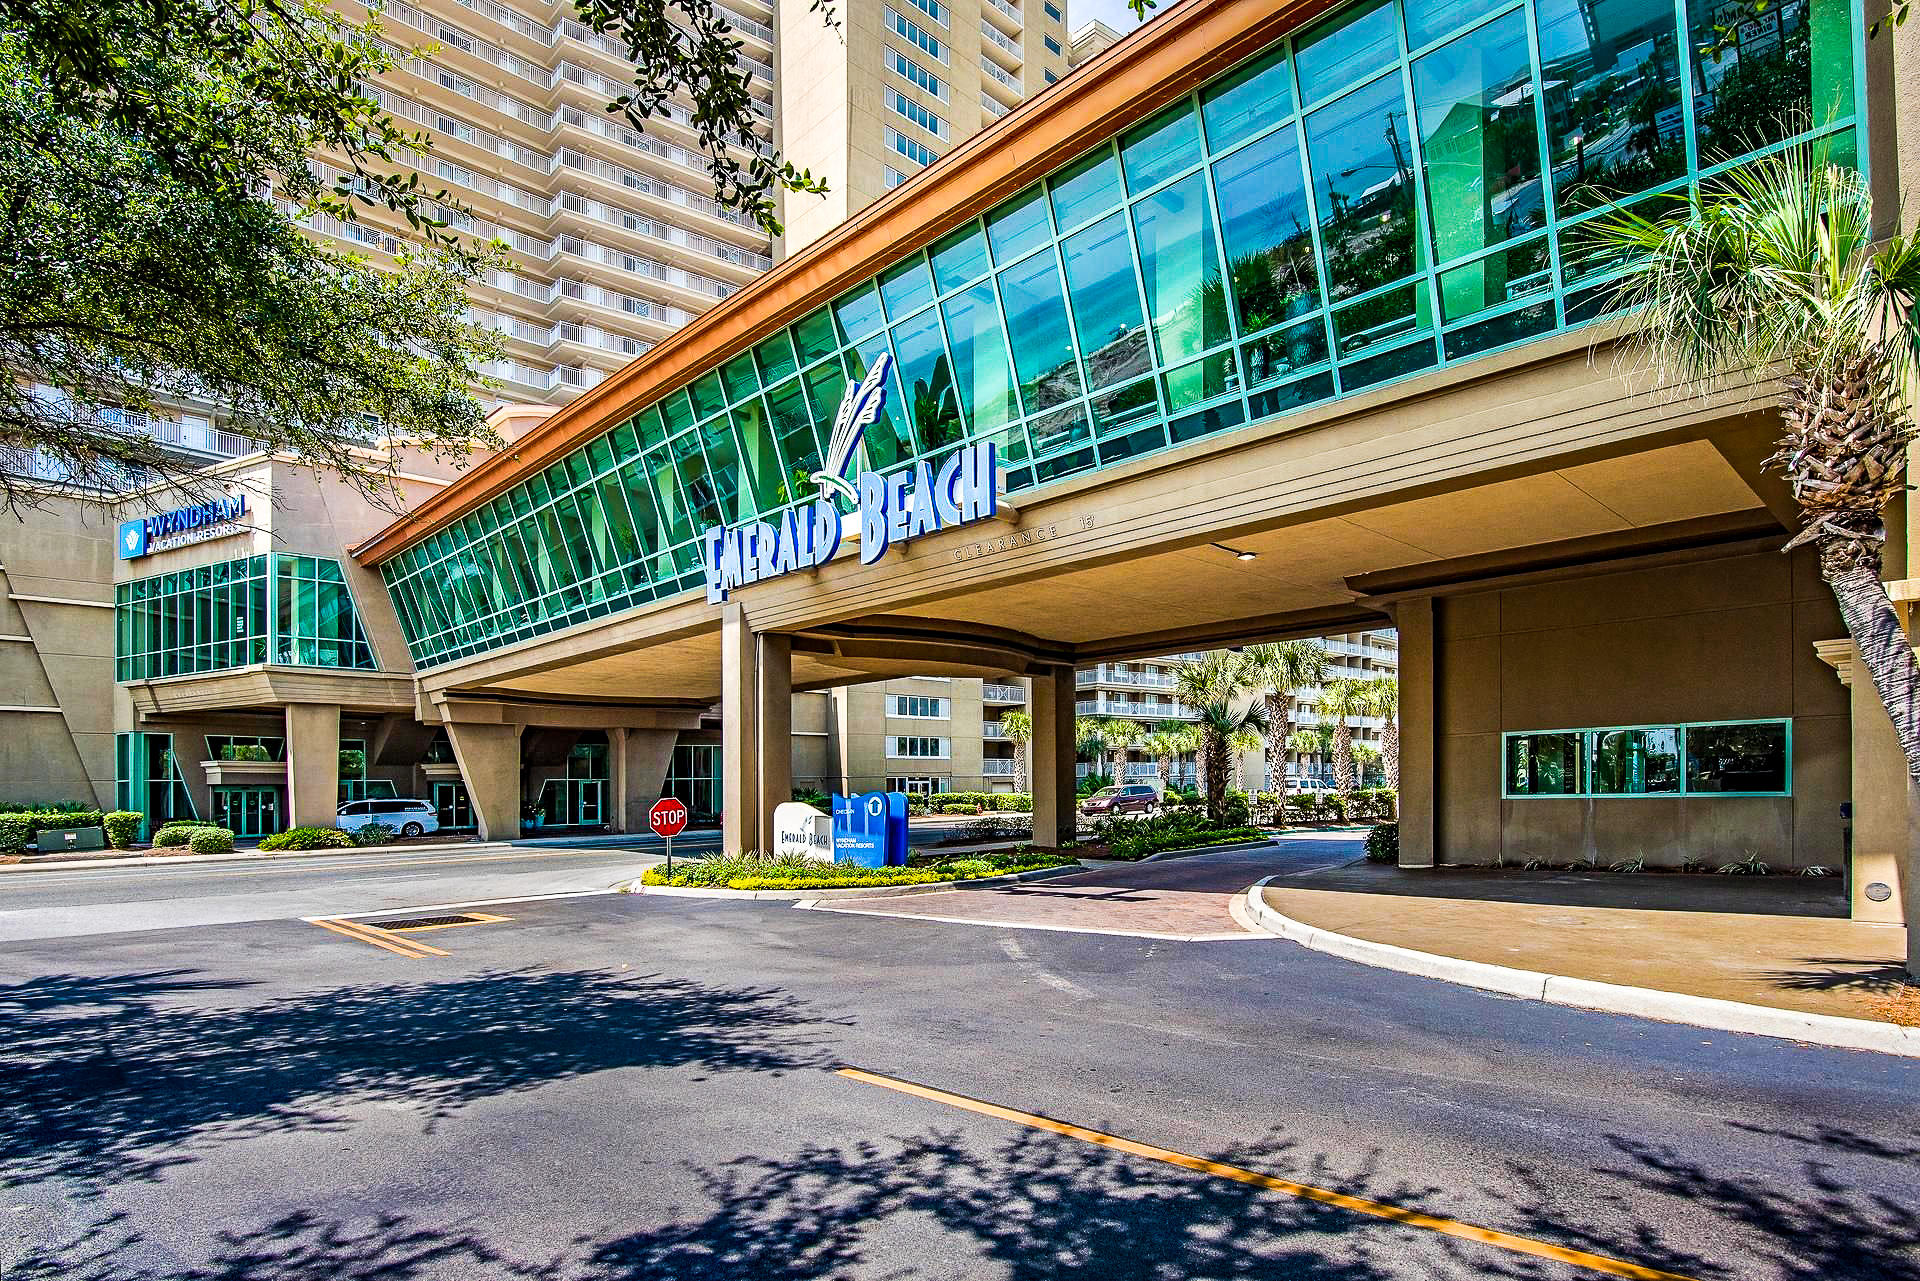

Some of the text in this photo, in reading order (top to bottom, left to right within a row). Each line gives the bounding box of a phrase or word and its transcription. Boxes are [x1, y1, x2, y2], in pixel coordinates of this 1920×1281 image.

[150, 494, 245, 537] WYNDHAM
[706, 441, 996, 605] EMERALD BEACH
[149, 534, 195, 553] VACATION
[953, 526, 1057, 560] CLEARANCE
[652, 809, 685, 826] STOP
[781, 830, 828, 847] EMERALD BEACH
